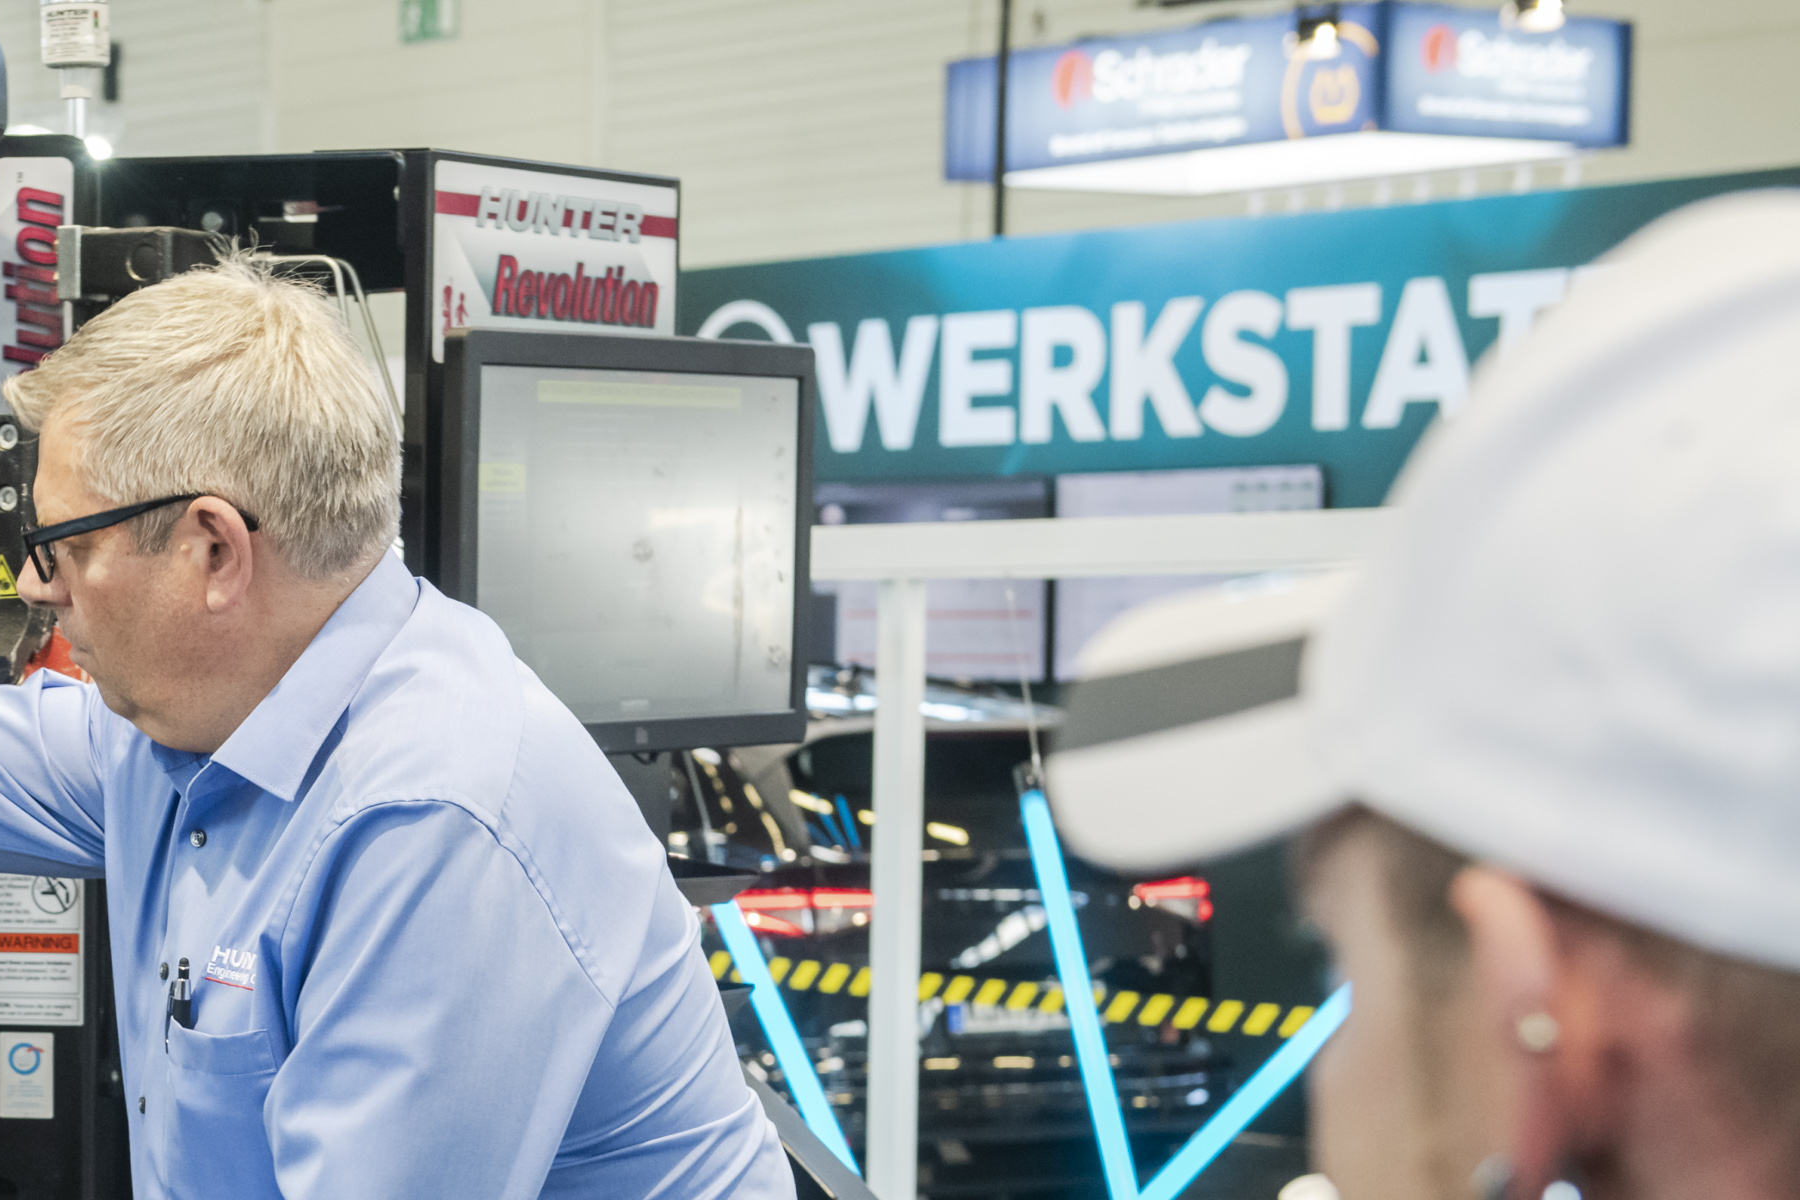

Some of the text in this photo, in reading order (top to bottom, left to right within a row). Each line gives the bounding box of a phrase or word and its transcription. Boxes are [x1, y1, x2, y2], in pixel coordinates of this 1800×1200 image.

[476, 187, 645, 244] HUNTER
[3, 187, 64, 375] lution
[492, 254, 659, 328] Revolution
[807, 262, 1598, 453] WERKSTAT
[211, 945, 257, 970] HUN
